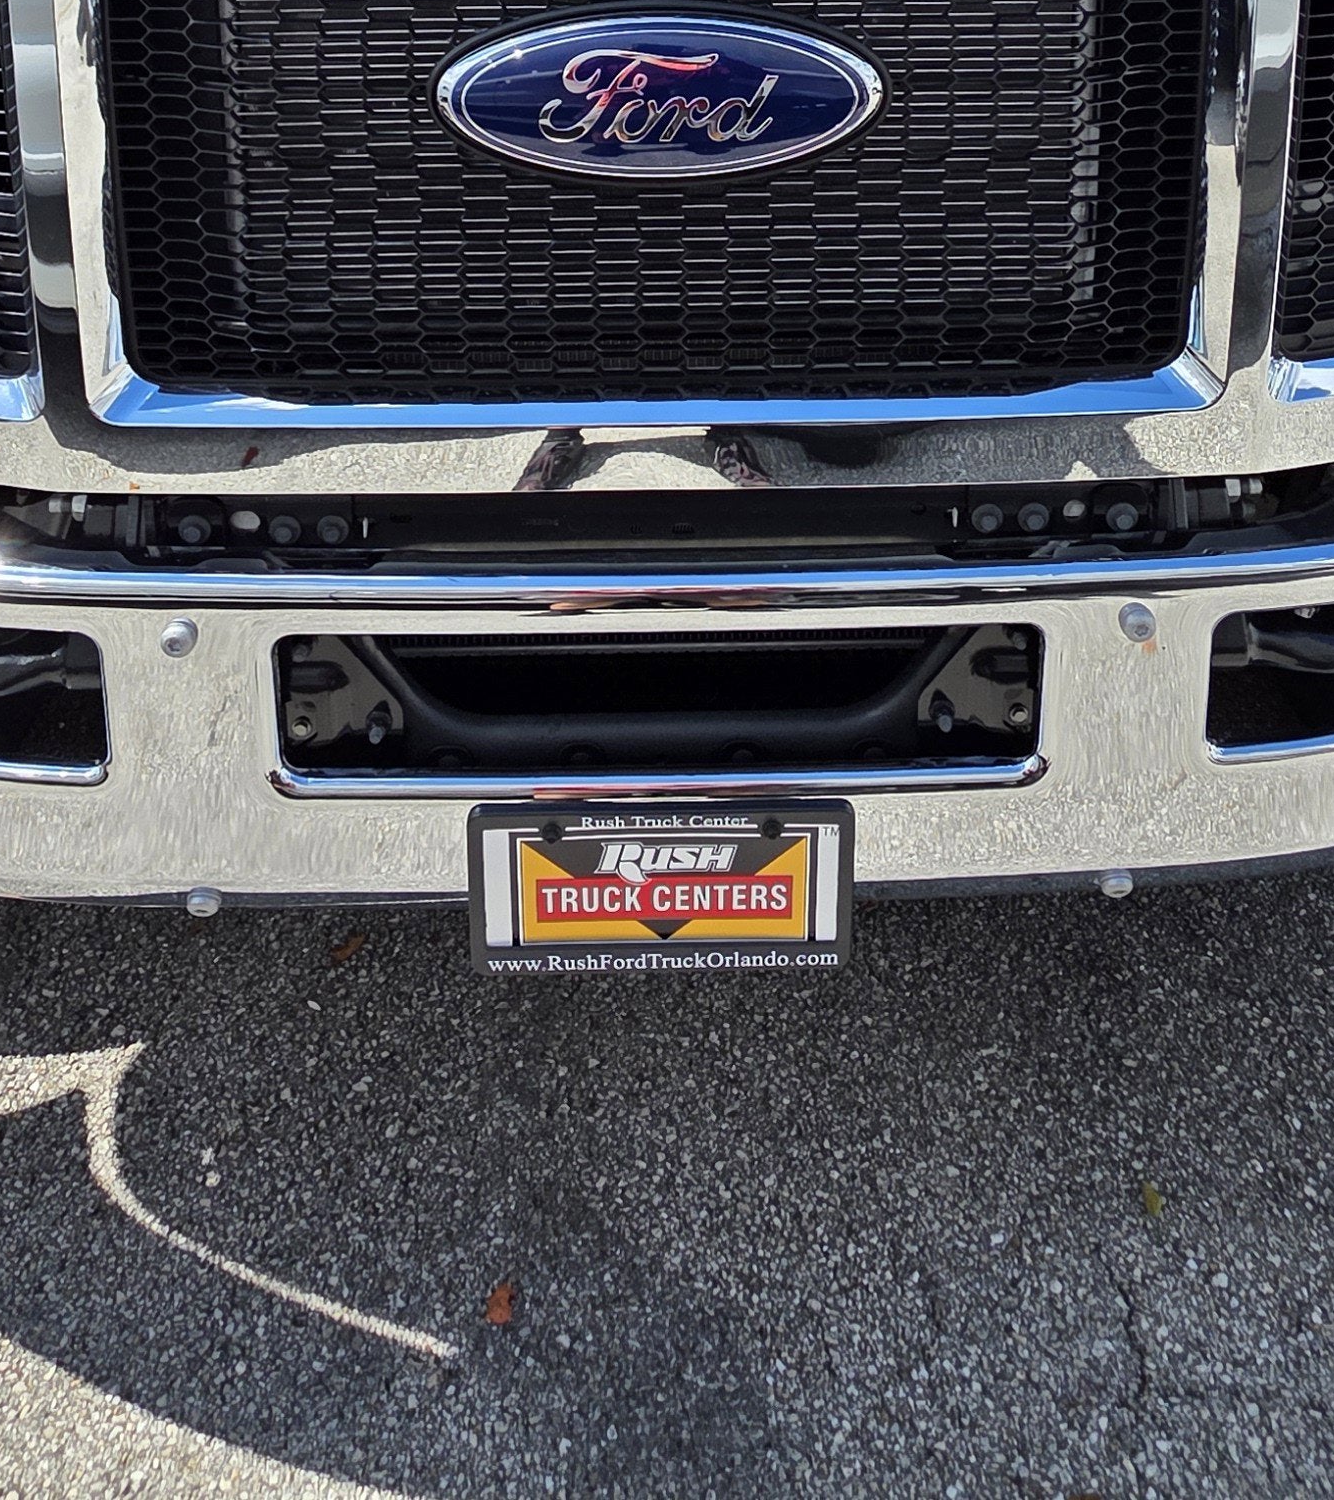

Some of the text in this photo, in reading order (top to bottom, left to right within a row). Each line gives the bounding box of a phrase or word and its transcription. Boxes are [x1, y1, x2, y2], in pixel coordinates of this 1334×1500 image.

[538, 49, 779, 143] Ford
[581, 814, 749, 828] Rush Truck Center
[541, 883, 788, 914] TRUCK CENTERS
[487, 950, 839, 973] www.RushFordTruckOrlando.com
